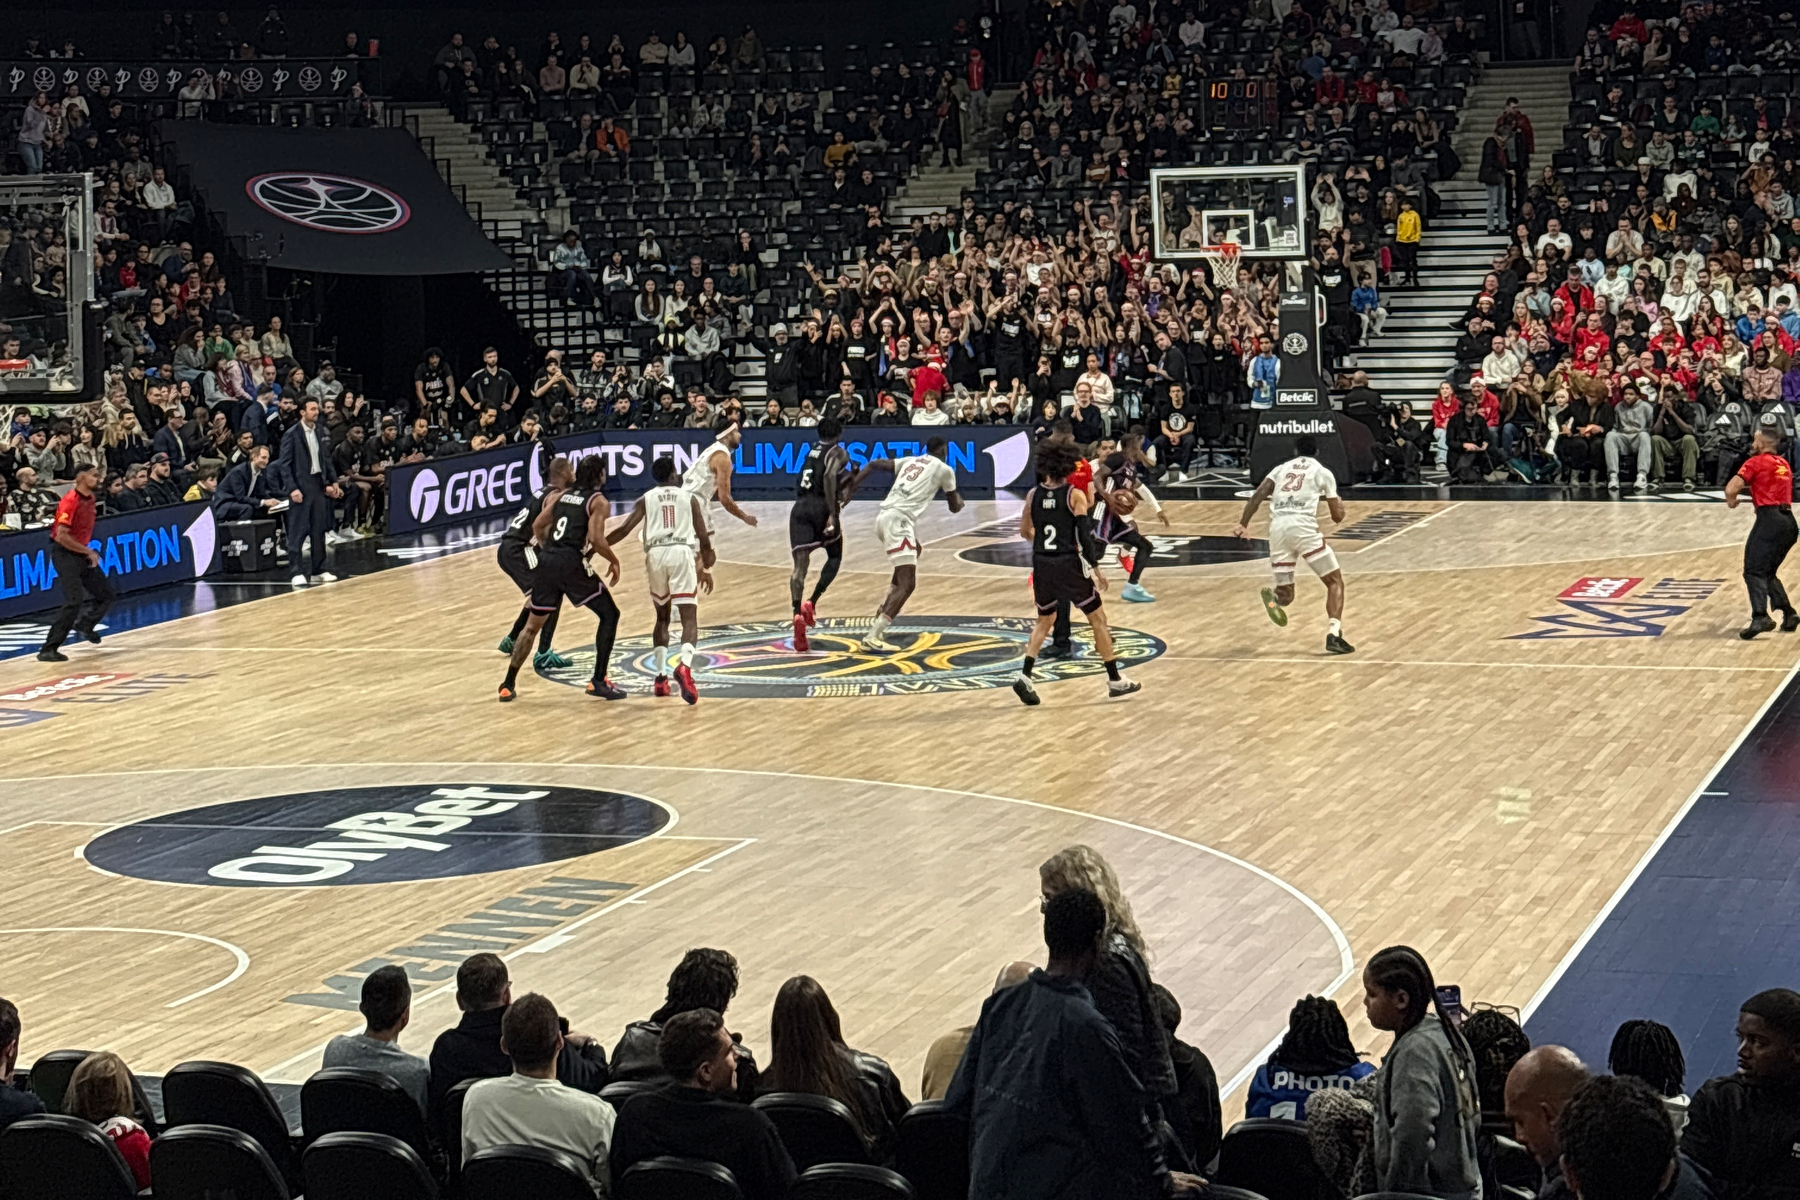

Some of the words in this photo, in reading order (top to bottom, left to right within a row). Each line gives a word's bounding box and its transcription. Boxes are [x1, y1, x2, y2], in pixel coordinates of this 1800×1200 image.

[1279, 391, 1314, 403] Betclic
[445, 460, 524, 515] GREE
[1281, 472, 1306, 492] 23
[1042, 498, 1056, 509] HIFI
[553, 516, 568, 541] 9
[662, 504, 675, 529] 11
[1043, 524, 1058, 550] 2
[207, 786, 551, 883] OlyBet
[1272, 1071, 1355, 1092] PHOTO
